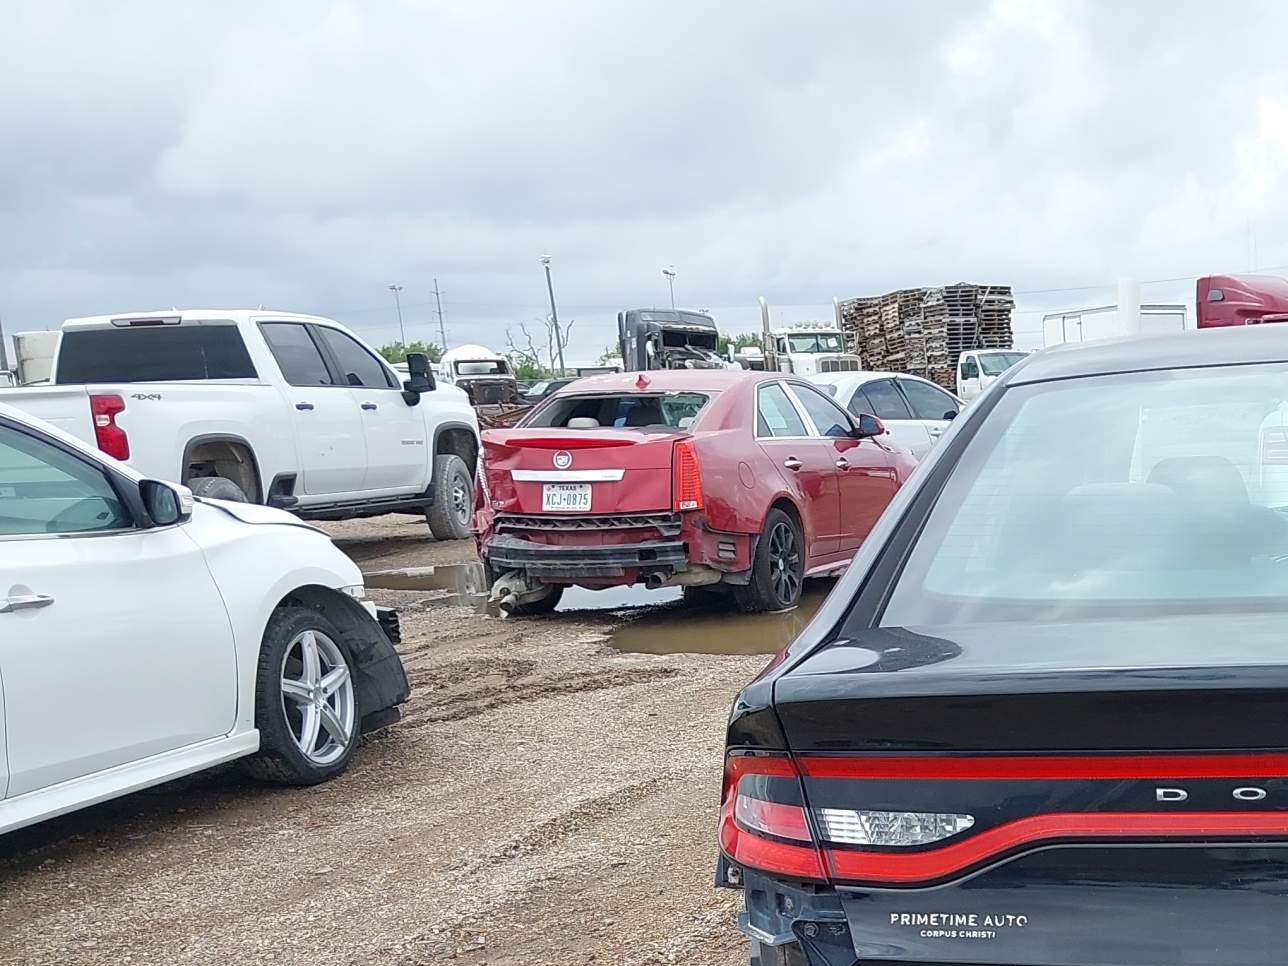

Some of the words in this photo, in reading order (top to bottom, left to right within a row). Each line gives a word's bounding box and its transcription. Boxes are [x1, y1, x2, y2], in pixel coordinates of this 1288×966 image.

[889, 912, 979, 927] PRIMETIME
[983, 914, 1028, 927] AUTO
[919, 930, 957, 938] CORPUS
[959, 930, 996, 939] CHRISTI
